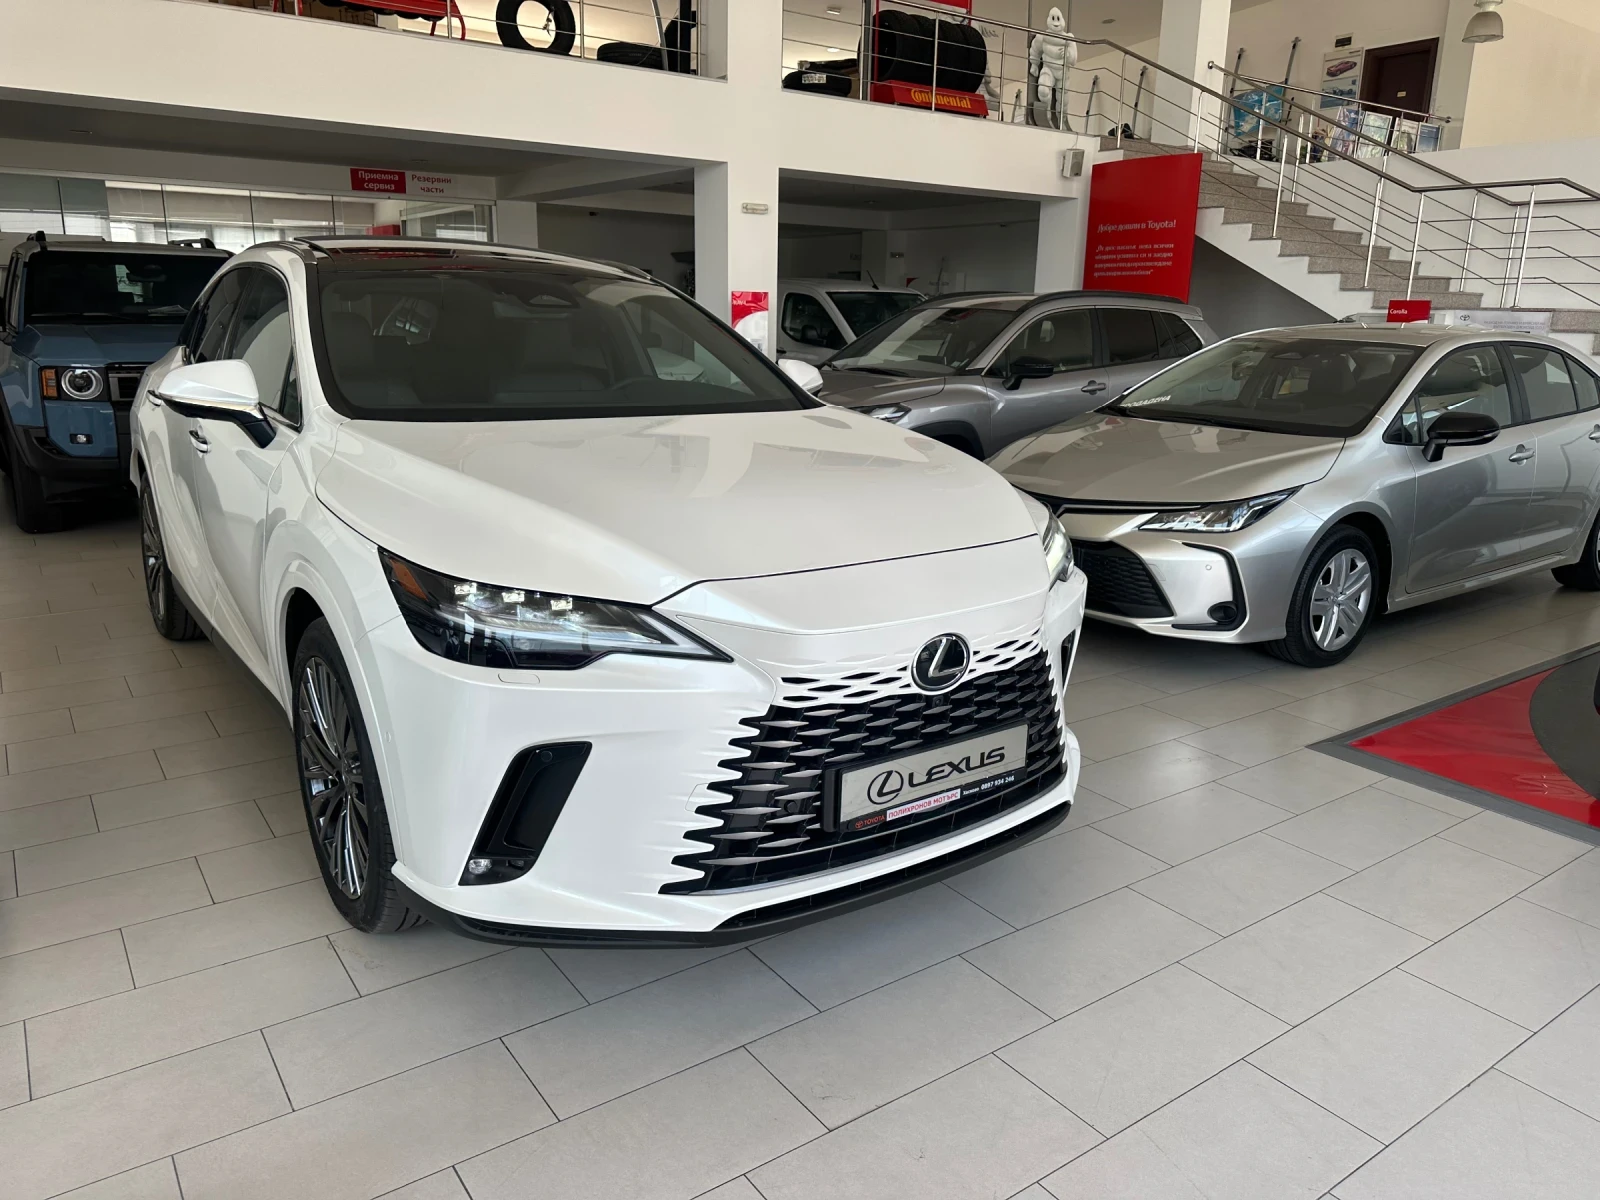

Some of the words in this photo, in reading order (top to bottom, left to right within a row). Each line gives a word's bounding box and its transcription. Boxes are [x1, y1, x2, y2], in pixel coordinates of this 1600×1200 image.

[358, 170, 399, 181] Приемна
[411, 173, 452, 184] Резервни
[363, 181, 395, 190] сервиз
[420, 185, 444, 194] части
[1147, 219, 1176, 230] Toyota!
[908, 746, 1006, 788] LEXUS
[888, 801, 932, 819] ПОЛИХРОНОВ
[933, 791, 959, 804] МОТЪРС
[864, 815, 885, 826] TOYOTA
